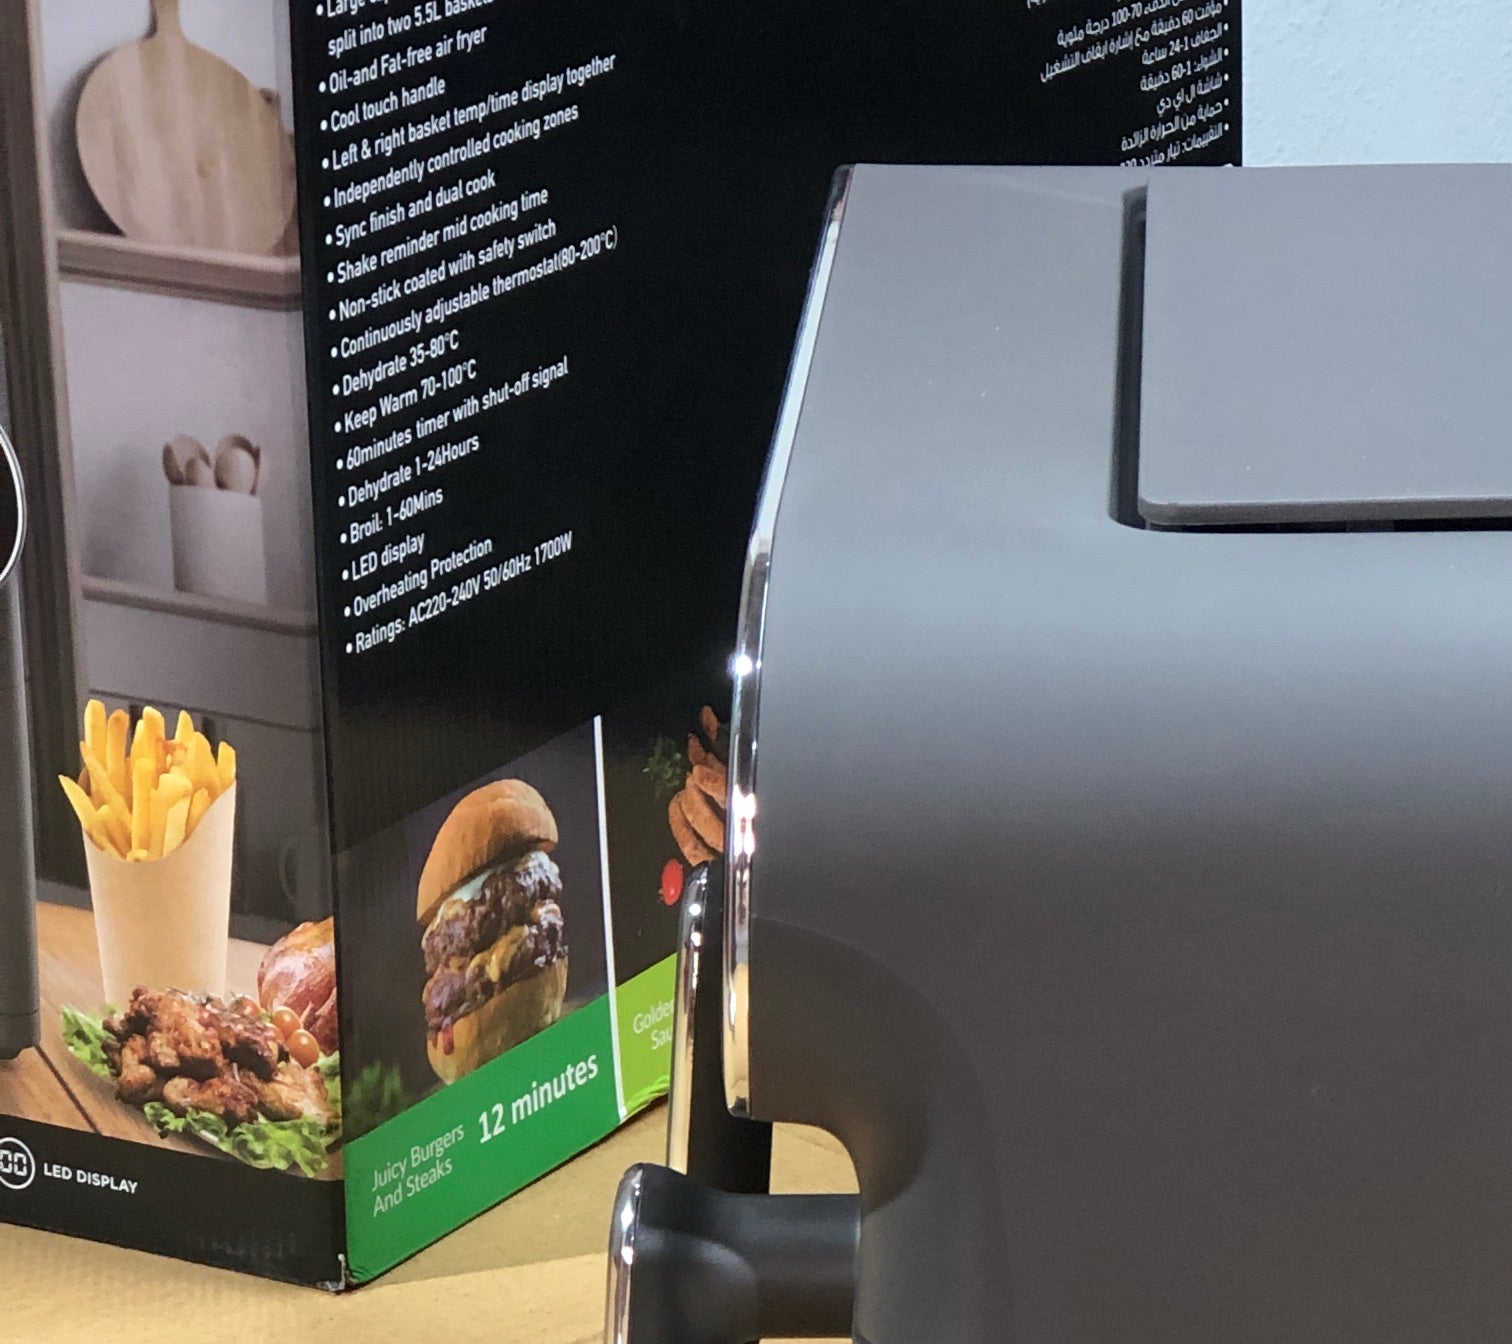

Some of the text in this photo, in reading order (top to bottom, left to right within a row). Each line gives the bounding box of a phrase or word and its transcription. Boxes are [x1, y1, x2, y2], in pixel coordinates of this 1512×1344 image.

[327, 28, 358, 58] split
[359, 21, 385, 46] into
[386, 14, 412, 36] two
[413, 0, 443, 27] 5.5L
[328, 26, 488, 94] Oil-and Fat-free air fryer
[330, 75, 446, 133] Cool touch handle
[332, 54, 616, 171] Left & right basket temp/time display together
[333, 104, 579, 209] Independently controlled cooking zones
[335, 168, 497, 248] Sync finish and dual cook
[336, 188, 549, 284] Shake reminder mid cooking time
[338, 218, 557, 322] Non-stick coated with safety switch
[340, 309, 423, 359] Continuously
[424, 282, 491, 324] adjustable
[342, 354, 408, 397] Dehydrate
[344, 406, 377, 434] Keep
[379, 388, 418, 417] Warm
[346, 355, 569, 471] 60minutes timer with shut-off signal
[348, 435, 480, 508] Dehydrate 1-24Hours
[349, 488, 444, 545] Broil: 1-60Mins
[351, 532, 425, 581] LED display
[353, 538, 493, 617] Overheating Protection
[355, 530, 573, 654] Ratings: AC220-240V 50/60Hz 1700W
[479, 1054, 599, 1144] 12 minutes
[43, 1162, 138, 1194] LED DISPLAY
[371, 1125, 465, 1192] Juicy Burgers
[373, 1158, 453, 1218] And Steaks
